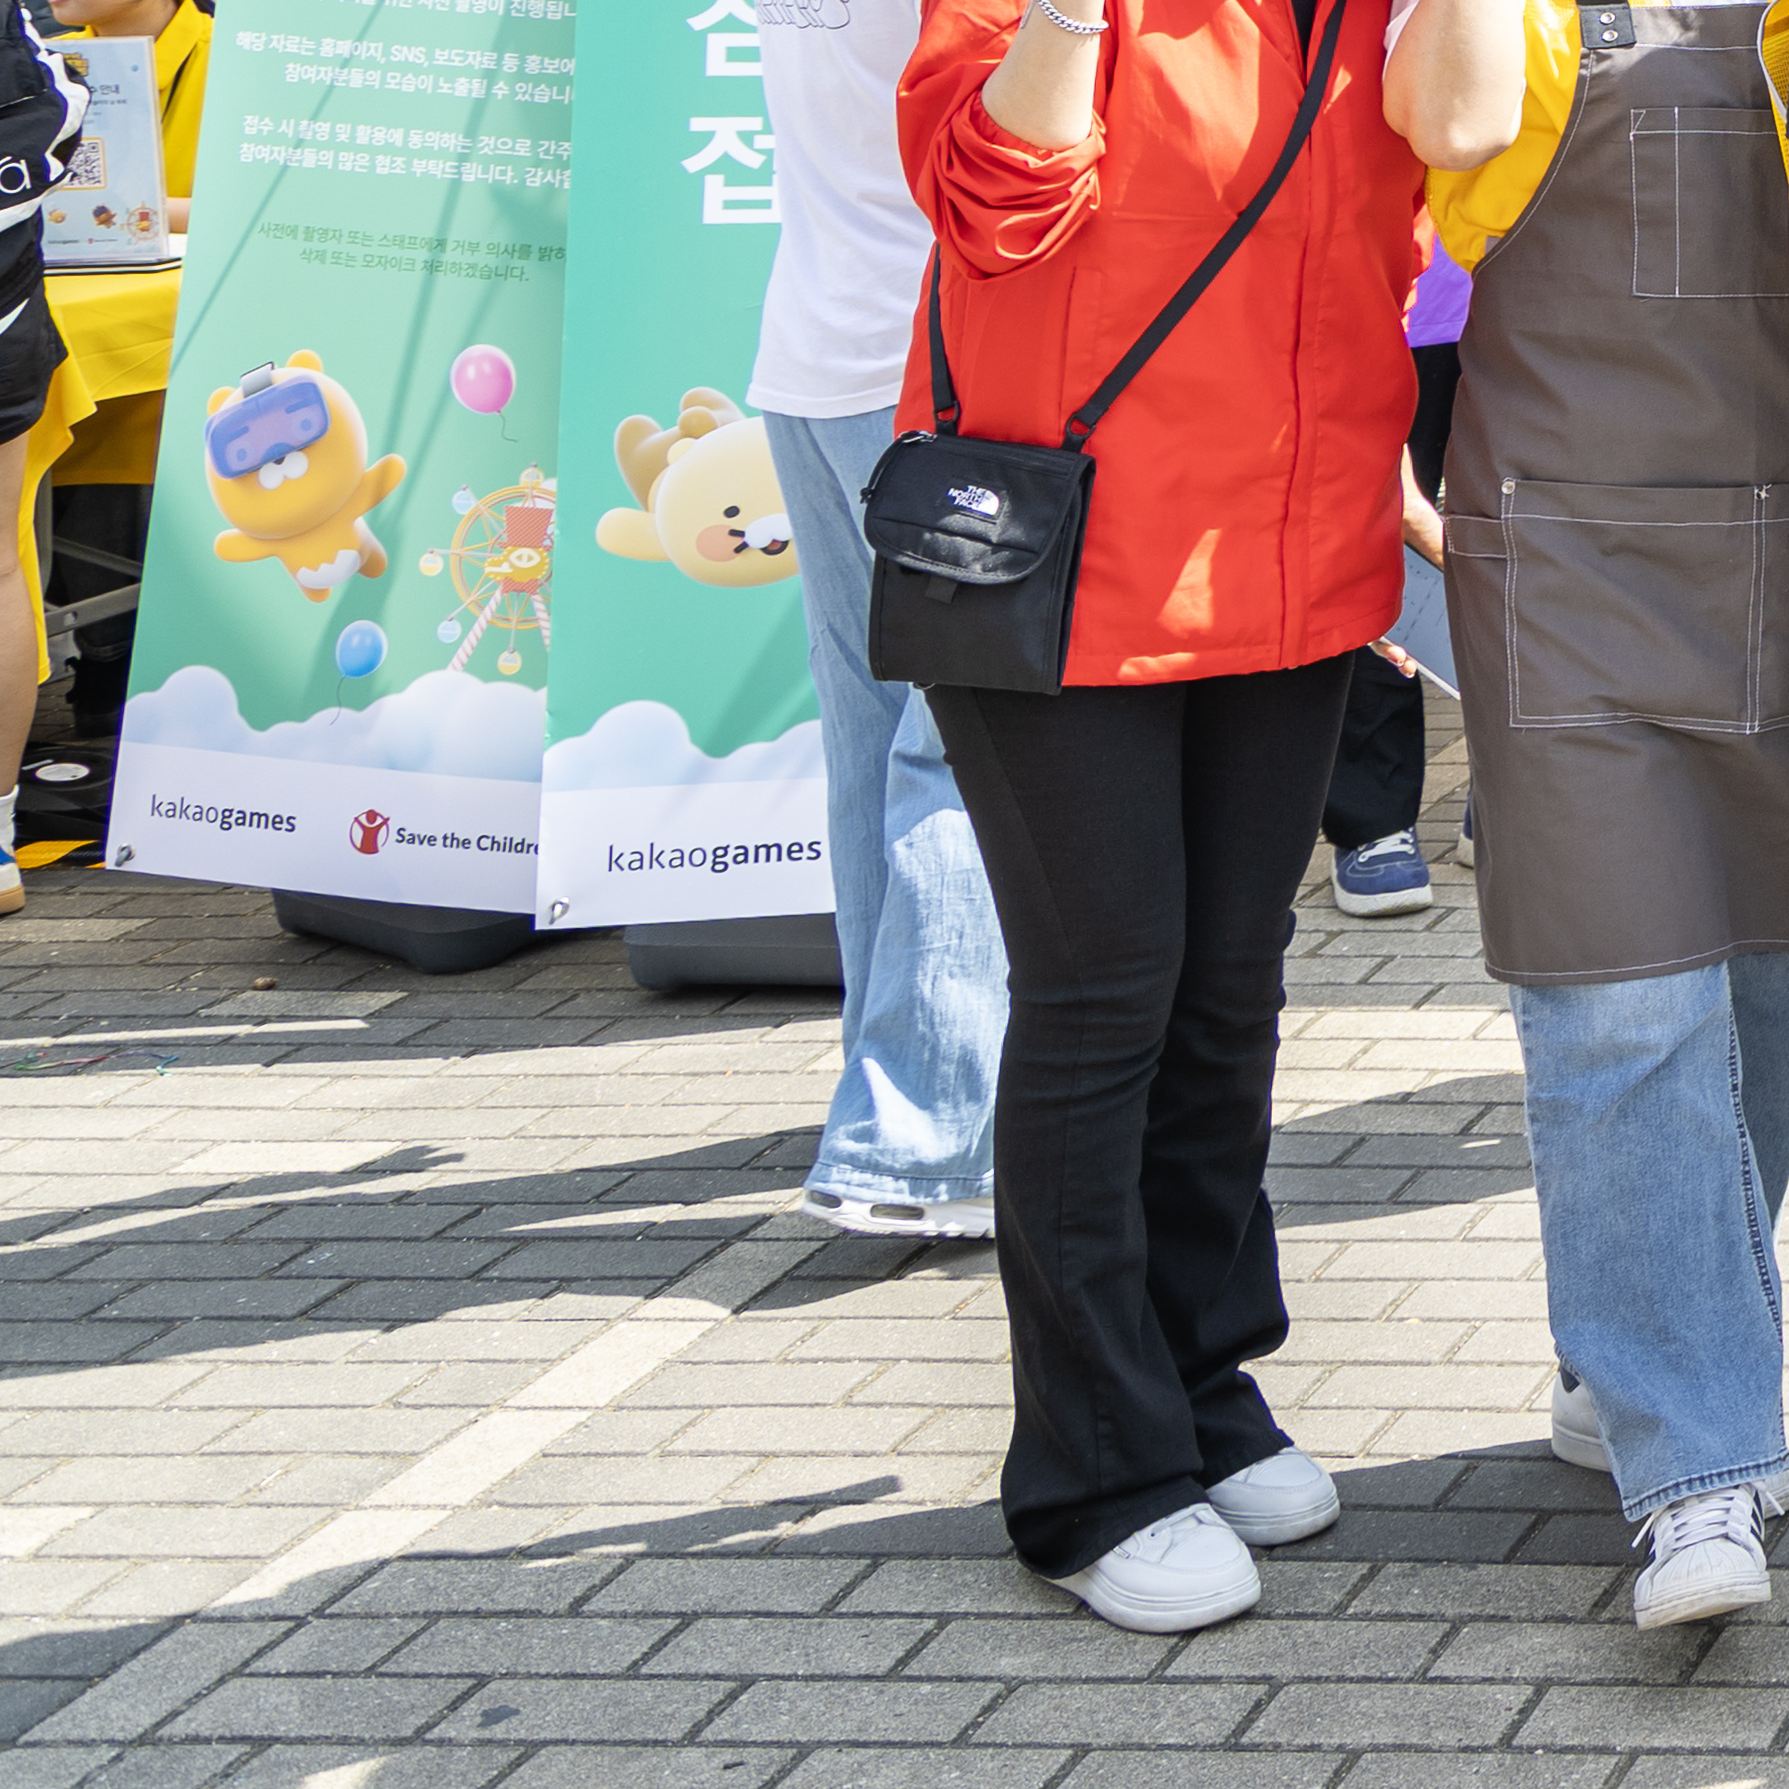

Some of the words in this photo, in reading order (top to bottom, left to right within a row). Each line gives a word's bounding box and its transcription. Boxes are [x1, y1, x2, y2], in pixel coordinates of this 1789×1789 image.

[235, 31, 267, 52] 해당
[268, 34, 317, 56] 자료는
[319, 37, 386, 64] 홈페이지,
[390, 45, 429, 67] SNS,
[433, 48, 498, 70] 보도자료
[502, 53, 520, 73] 등
[284, 62, 382, 90] 참여자분들의
[384, 71, 434, 95] 모습이
[436, 76, 488, 99] 노출될
[491, 80, 510, 100] 수
[514, 81, 574, 105] 있습니
[243, 114, 275, 136] 접수
[277, 118, 295, 139] 시
[298, 120, 331, 141] 촬영
[335, 123, 351, 143] 및
[355, 124, 405, 148] 활용에
[407, 129, 473, 154] 동의하는
[477, 135, 533, 157] 것으로
[239, 141, 335, 170] 참여자분들의
[338, 151, 371, 173] 많은
[374, 154, 407, 175] 협조
[411, 157, 519, 184] 부탁드립니다.
[258, 222, 299, 241] 사전에
[302, 225, 344, 245] 촬영자
[346, 230, 375, 247] 또는
[377, 233, 447, 254] 스태프에게
[450, 239, 481, 257] 거부
[485, 242, 533, 261] 의사를
[300, 247, 328, 265] 삭제
[330, 250, 358, 268] 또는
[361, 254, 416, 272] 모자이크
[421, 258, 530, 282] 처리하겠습니다.
[150, 793, 297, 833] kakaogames
[395, 827, 438, 849] Save
[441, 831, 471, 851] the
[607, 839, 823, 874] kakaogames
